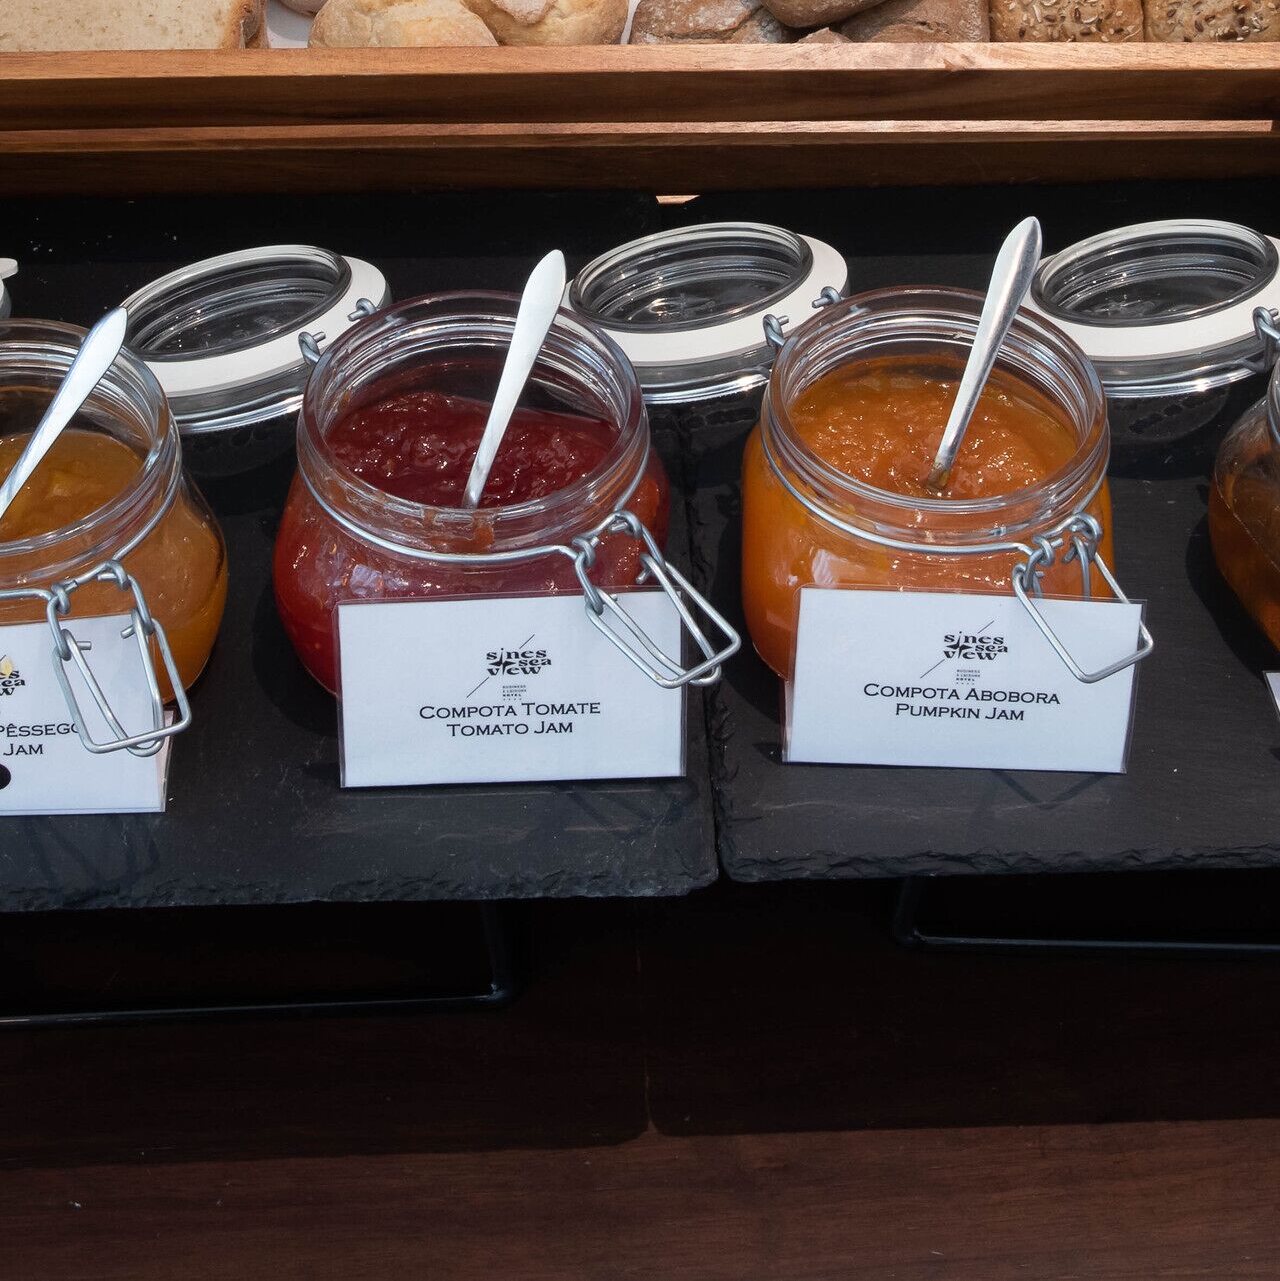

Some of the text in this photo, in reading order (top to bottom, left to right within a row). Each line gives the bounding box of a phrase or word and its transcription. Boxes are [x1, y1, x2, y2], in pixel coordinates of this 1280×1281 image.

[863, 682, 1061, 704] COMPOTA ABOBORA
[419, 701, 602, 720] COMPOTA TOMATE
[895, 702, 1025, 721] PUMPKIN JAM
[446, 720, 574, 737] TOMATO JAM
[2, 743, 44, 757] JAM
